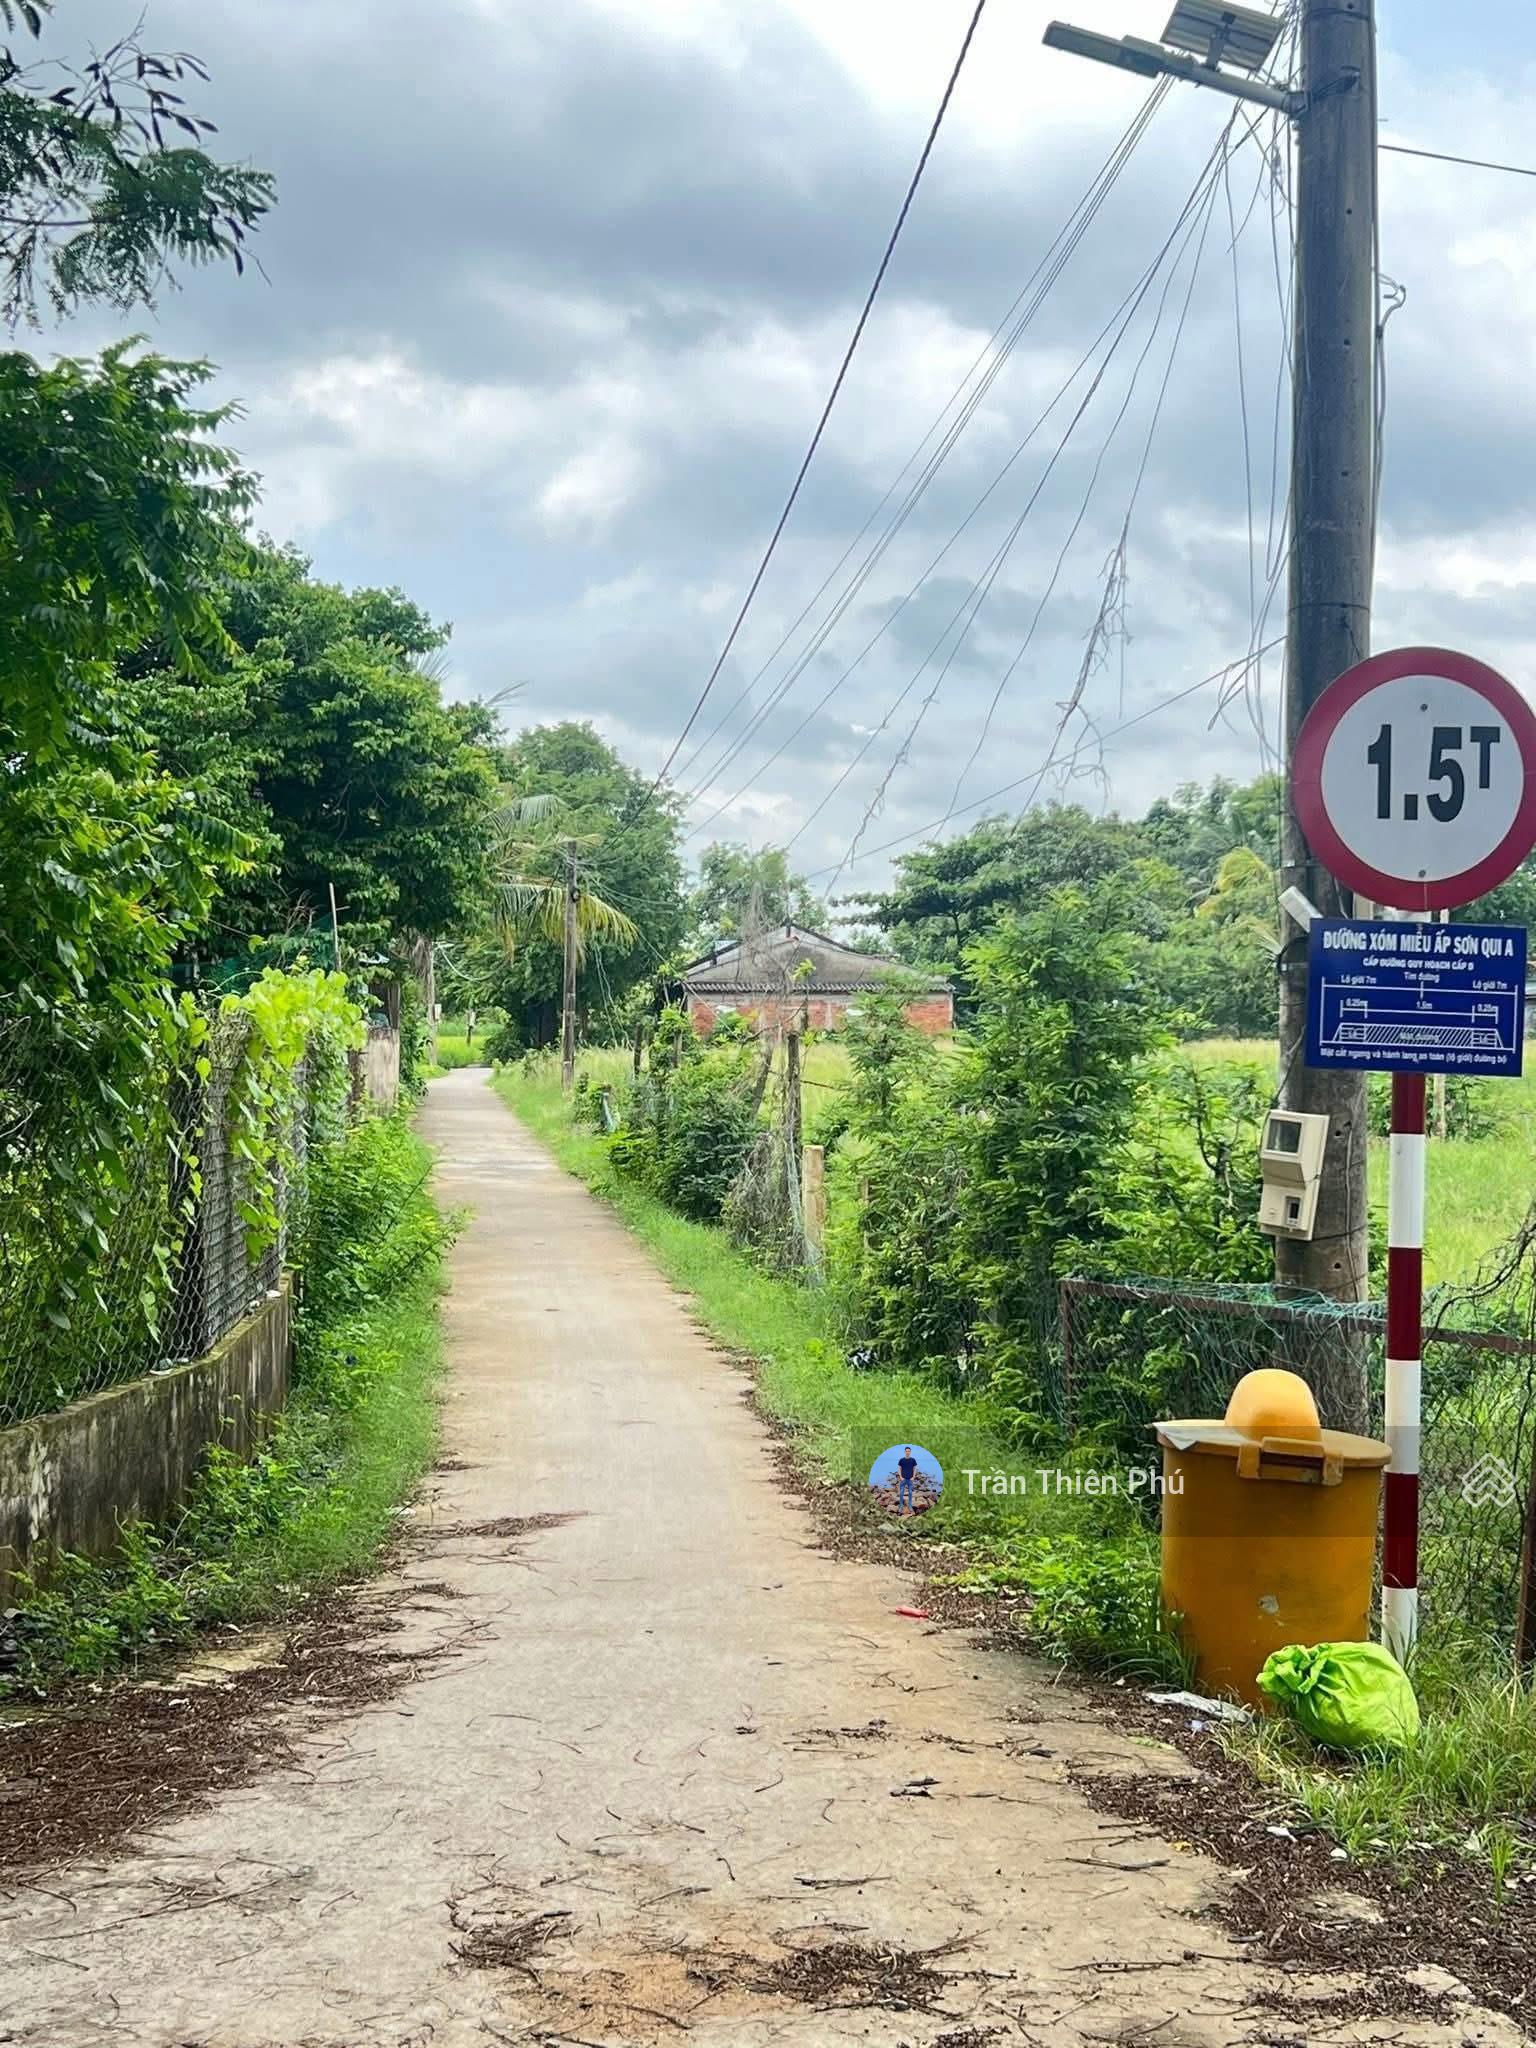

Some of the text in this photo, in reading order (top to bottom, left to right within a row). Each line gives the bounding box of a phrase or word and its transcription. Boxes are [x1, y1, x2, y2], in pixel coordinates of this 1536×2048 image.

[1367, 724, 1500, 823] 1.5T
[1323, 928, 1367, 950] ĐƯỜNG
[1369, 928, 1397, 951] XÓM
[1433, 929, 1451, 953] ẤP
[1453, 935, 1479, 955] SƠN
[1481, 937, 1502, 958] QUI
[1504, 939, 1514, 957] A
